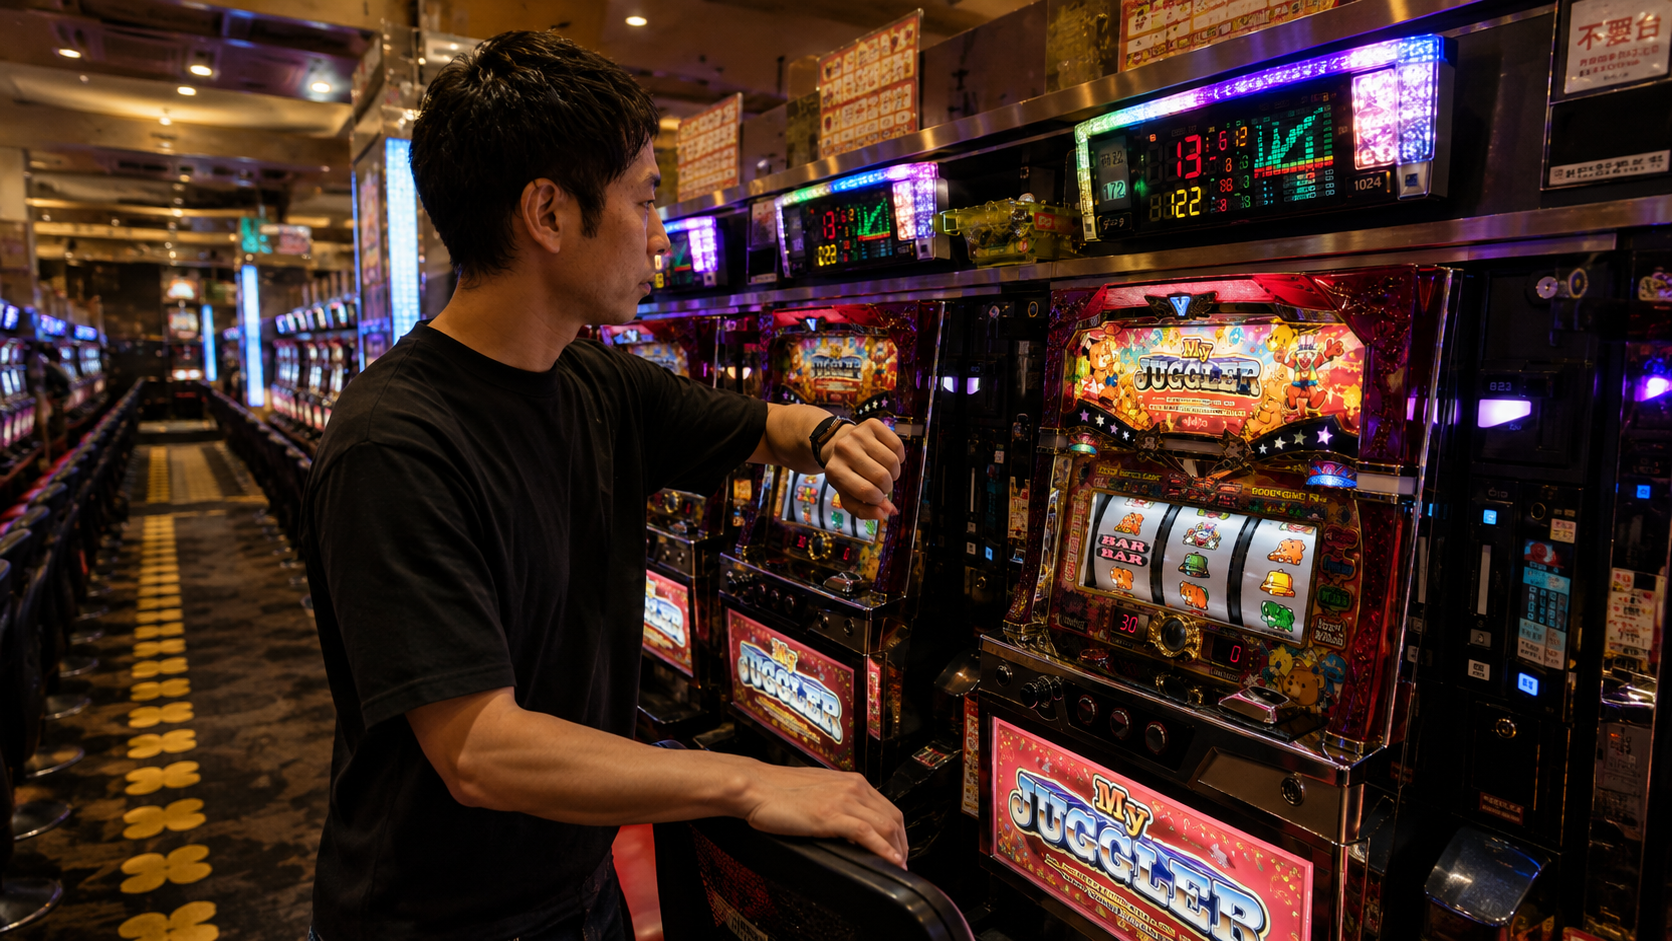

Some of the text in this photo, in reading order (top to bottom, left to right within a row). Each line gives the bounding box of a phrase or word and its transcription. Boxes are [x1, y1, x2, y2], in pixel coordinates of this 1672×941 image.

[1176, 134, 1202, 179] 13
[1354, 176, 1382, 191] 1024
[1171, 186, 1202, 218] 122
[1182, 338, 1213, 363] My
[1134, 357, 1261, 397] JUGGLER
[1119, 613, 1139, 634] 30
[1230, 645, 1242, 663] 0
[738, 642, 842, 742] JUGGLER
[1094, 775, 1152, 836] My
[1010, 770, 1269, 941] JUGGLER
